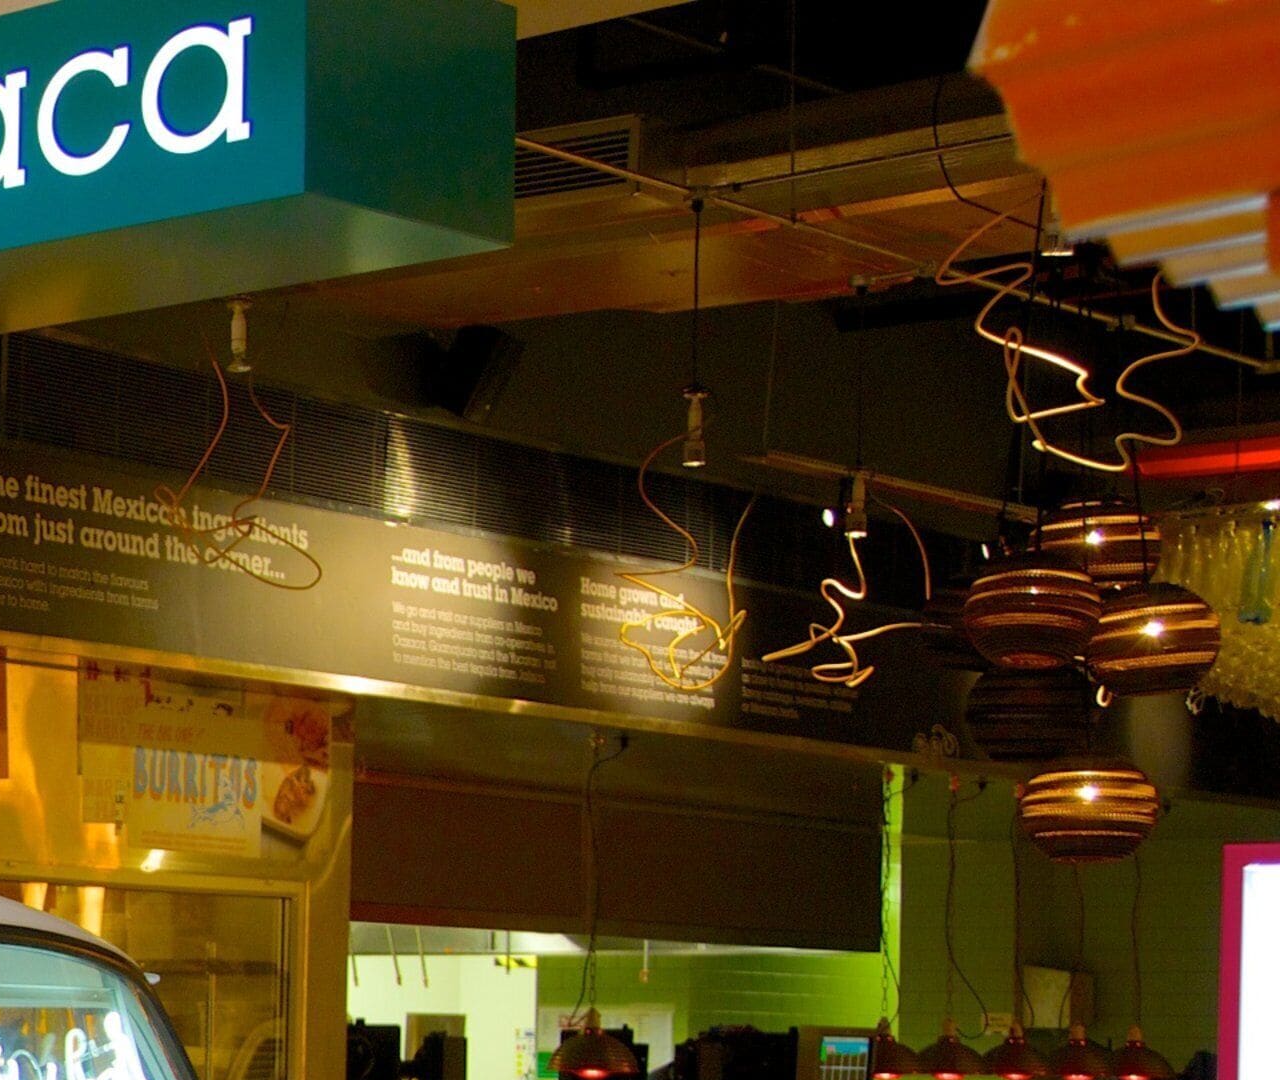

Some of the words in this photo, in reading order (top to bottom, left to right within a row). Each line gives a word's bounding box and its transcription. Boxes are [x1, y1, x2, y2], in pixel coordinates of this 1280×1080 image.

[25, 474, 87, 511] finest
[92, 485, 186, 528] Mexican
[34, 516, 75, 544] just
[80, 525, 160, 559] around
[165, 535, 198, 564] the
[392, 566, 429, 590] know
[432, 576, 459, 596] and
[462, 580, 493, 601] trust
[495, 584, 510, 603] in
[511, 588, 558, 613] Mexico
[435, 550, 464, 573] from
[468, 559, 513, 584] people
[517, 567, 536, 585] we
[580, 576, 616, 599] Home
[618, 583, 657, 608] grown
[133, 745, 259, 811] BURRITOS
